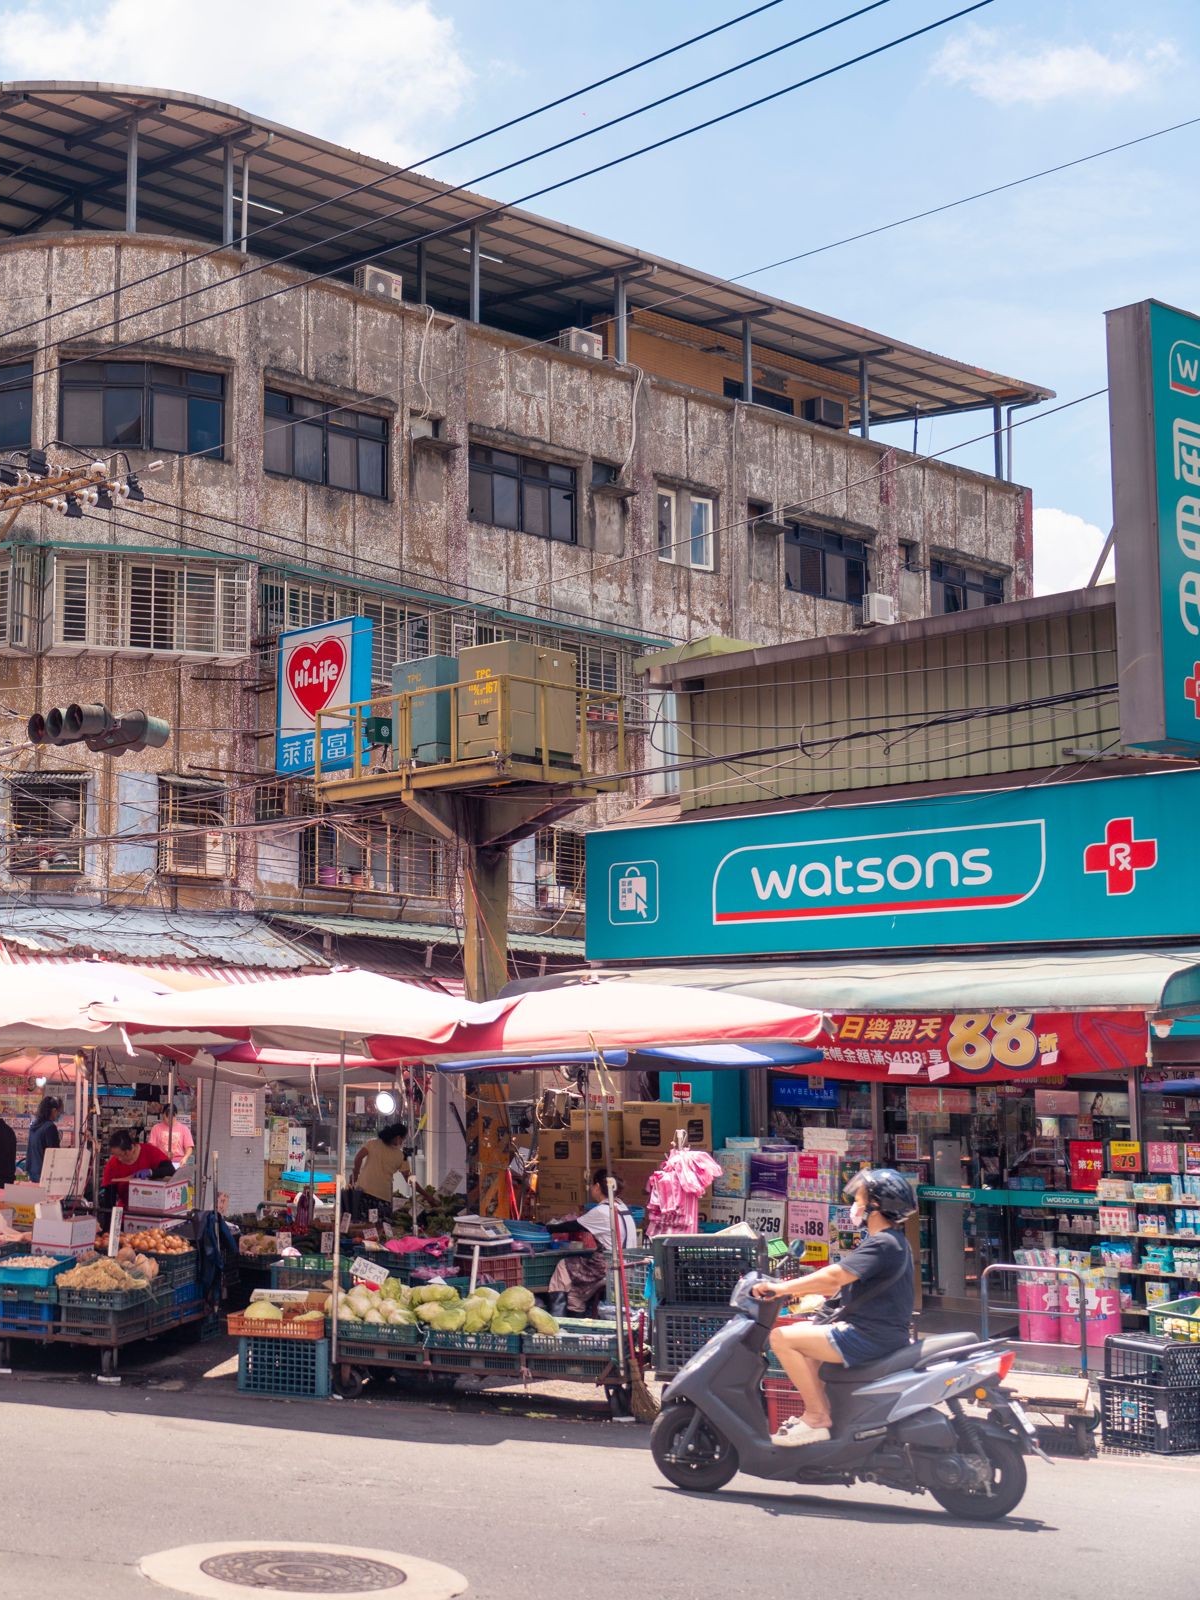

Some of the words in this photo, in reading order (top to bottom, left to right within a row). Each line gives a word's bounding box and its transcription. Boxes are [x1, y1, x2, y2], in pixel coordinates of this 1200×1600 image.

[475, 668, 492, 680] TPC
[751, 847, 993, 900] watsons
[833, 1016, 942, 1041] 日樂翻天
[799, 1220, 824, 1237] $188
